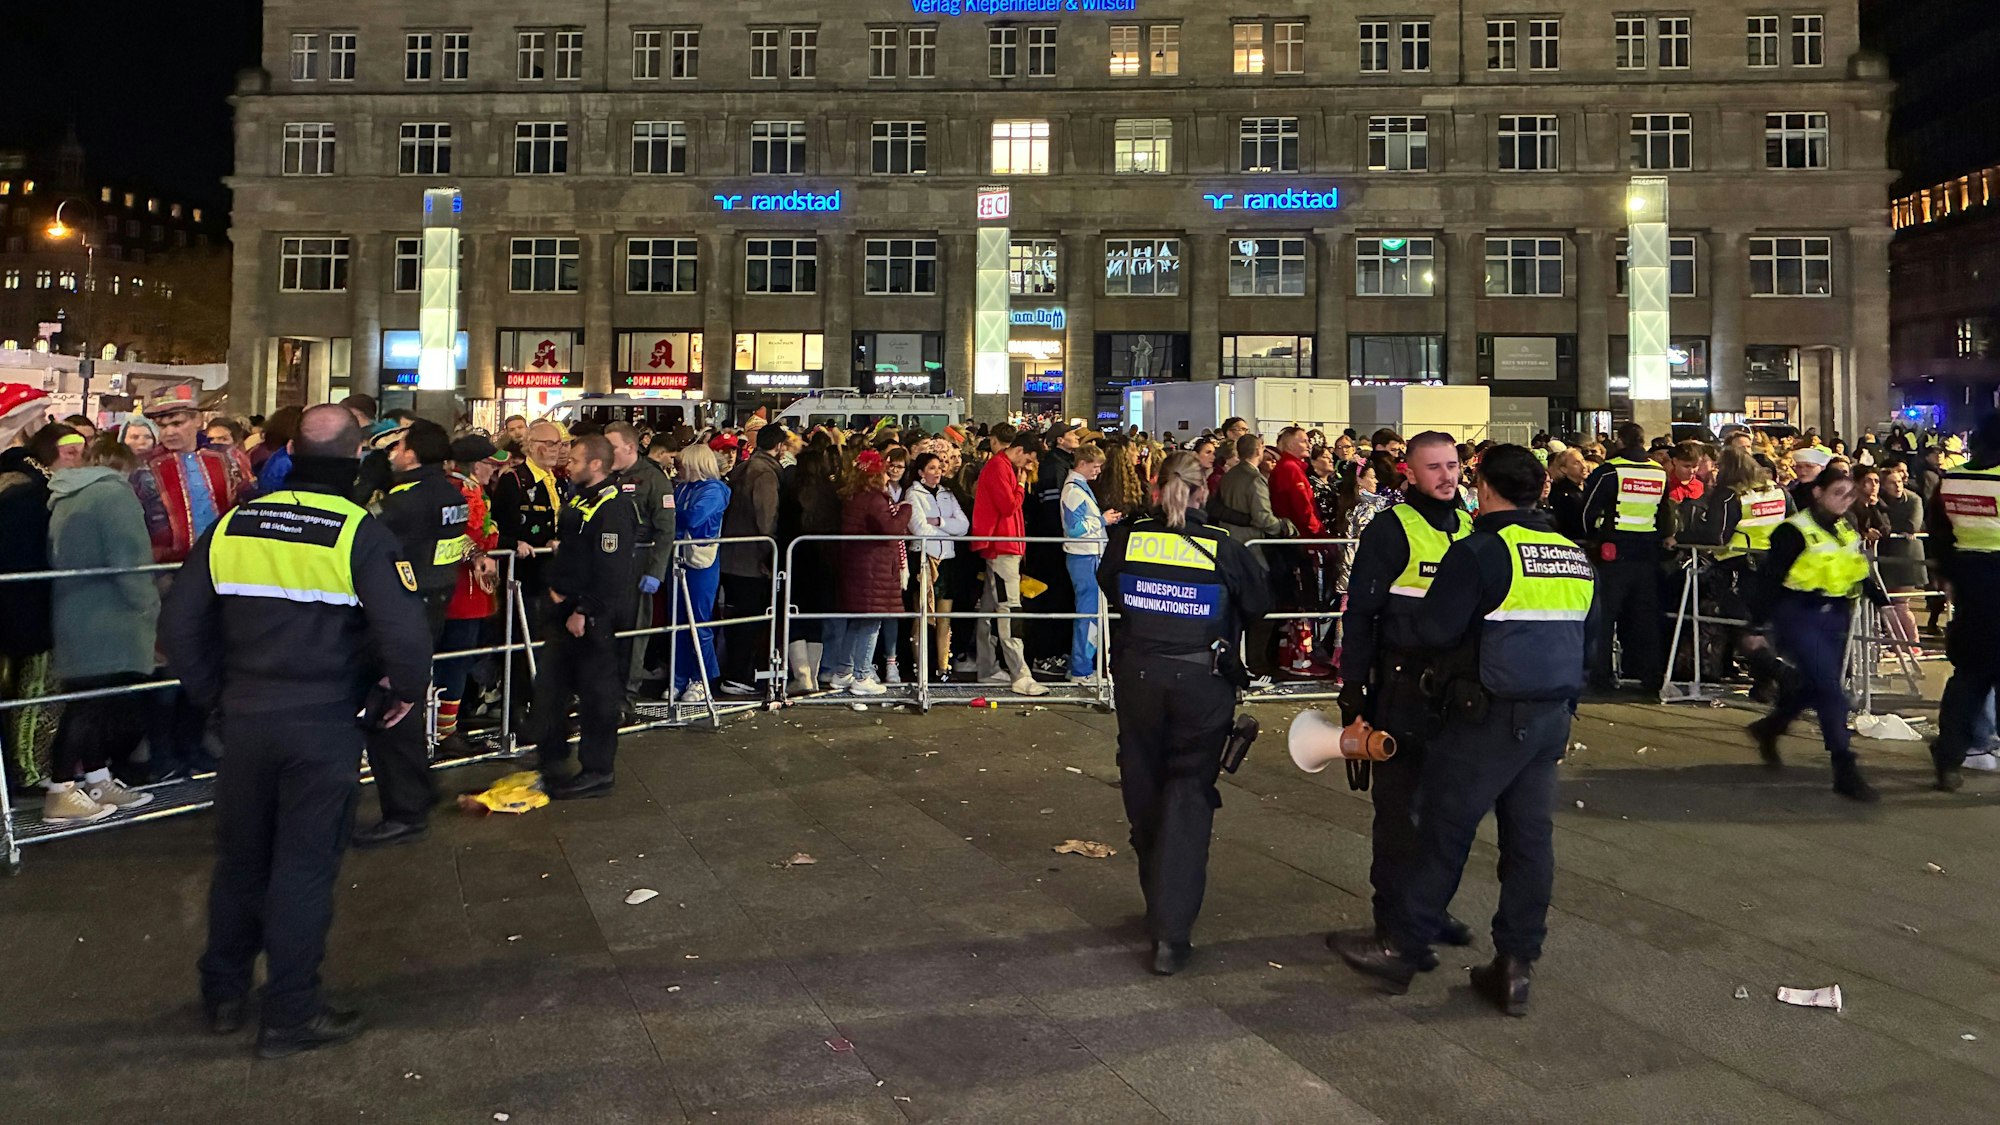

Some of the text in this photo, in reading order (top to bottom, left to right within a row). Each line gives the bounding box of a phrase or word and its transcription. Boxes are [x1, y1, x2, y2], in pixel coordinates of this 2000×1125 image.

[912, 0, 960, 16] Verlag
[751, 189, 840, 211] randstad
[1243, 187, 1338, 210] randstad
[507, 373, 561, 386] DOM APOTHEKE
[633, 375, 688, 387] DOM APOTHEKE
[746, 374, 810, 385] TIME SQUARE
[1623, 483, 1633, 491] DB
[260, 509, 342, 528] Unterstützungsgruppe
[260, 522, 271, 530] DB
[1521, 545, 1588, 563] DB Sicherheit
[1136, 580, 1198, 600] BUNDESPOLIZEI
[1124, 593, 1211, 616] KOMMUNIKATIONSTEAM
